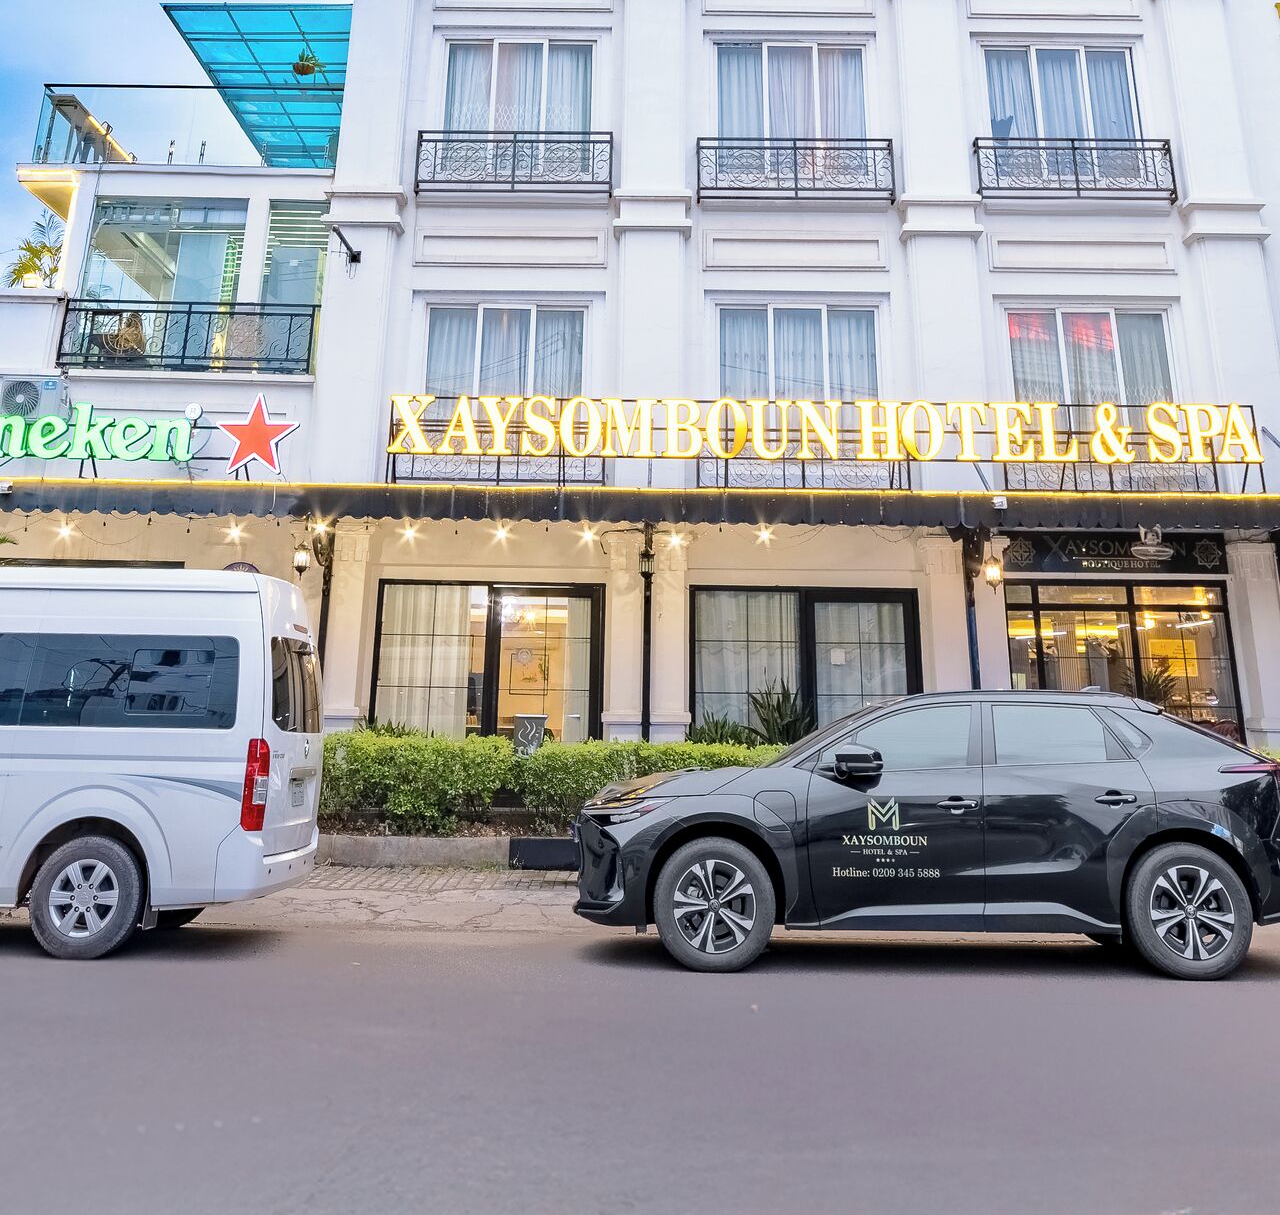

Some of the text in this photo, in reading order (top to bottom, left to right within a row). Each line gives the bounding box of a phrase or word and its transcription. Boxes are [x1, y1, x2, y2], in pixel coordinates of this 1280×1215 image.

[386, 394, 1265, 465] XAYSOMBOUN HOTEL & SPA
[1043, 534, 1188, 563] XAYSOMN
[1082, 559, 1161, 571] BOUTIQUE HOTEL
[842, 835, 928, 846] XAYSOMBOUN
[862, 848, 886, 856] HOTEL
[895, 848, 908, 856] SPA
[832, 867, 941, 879] Hotline: 0209 345 5888
